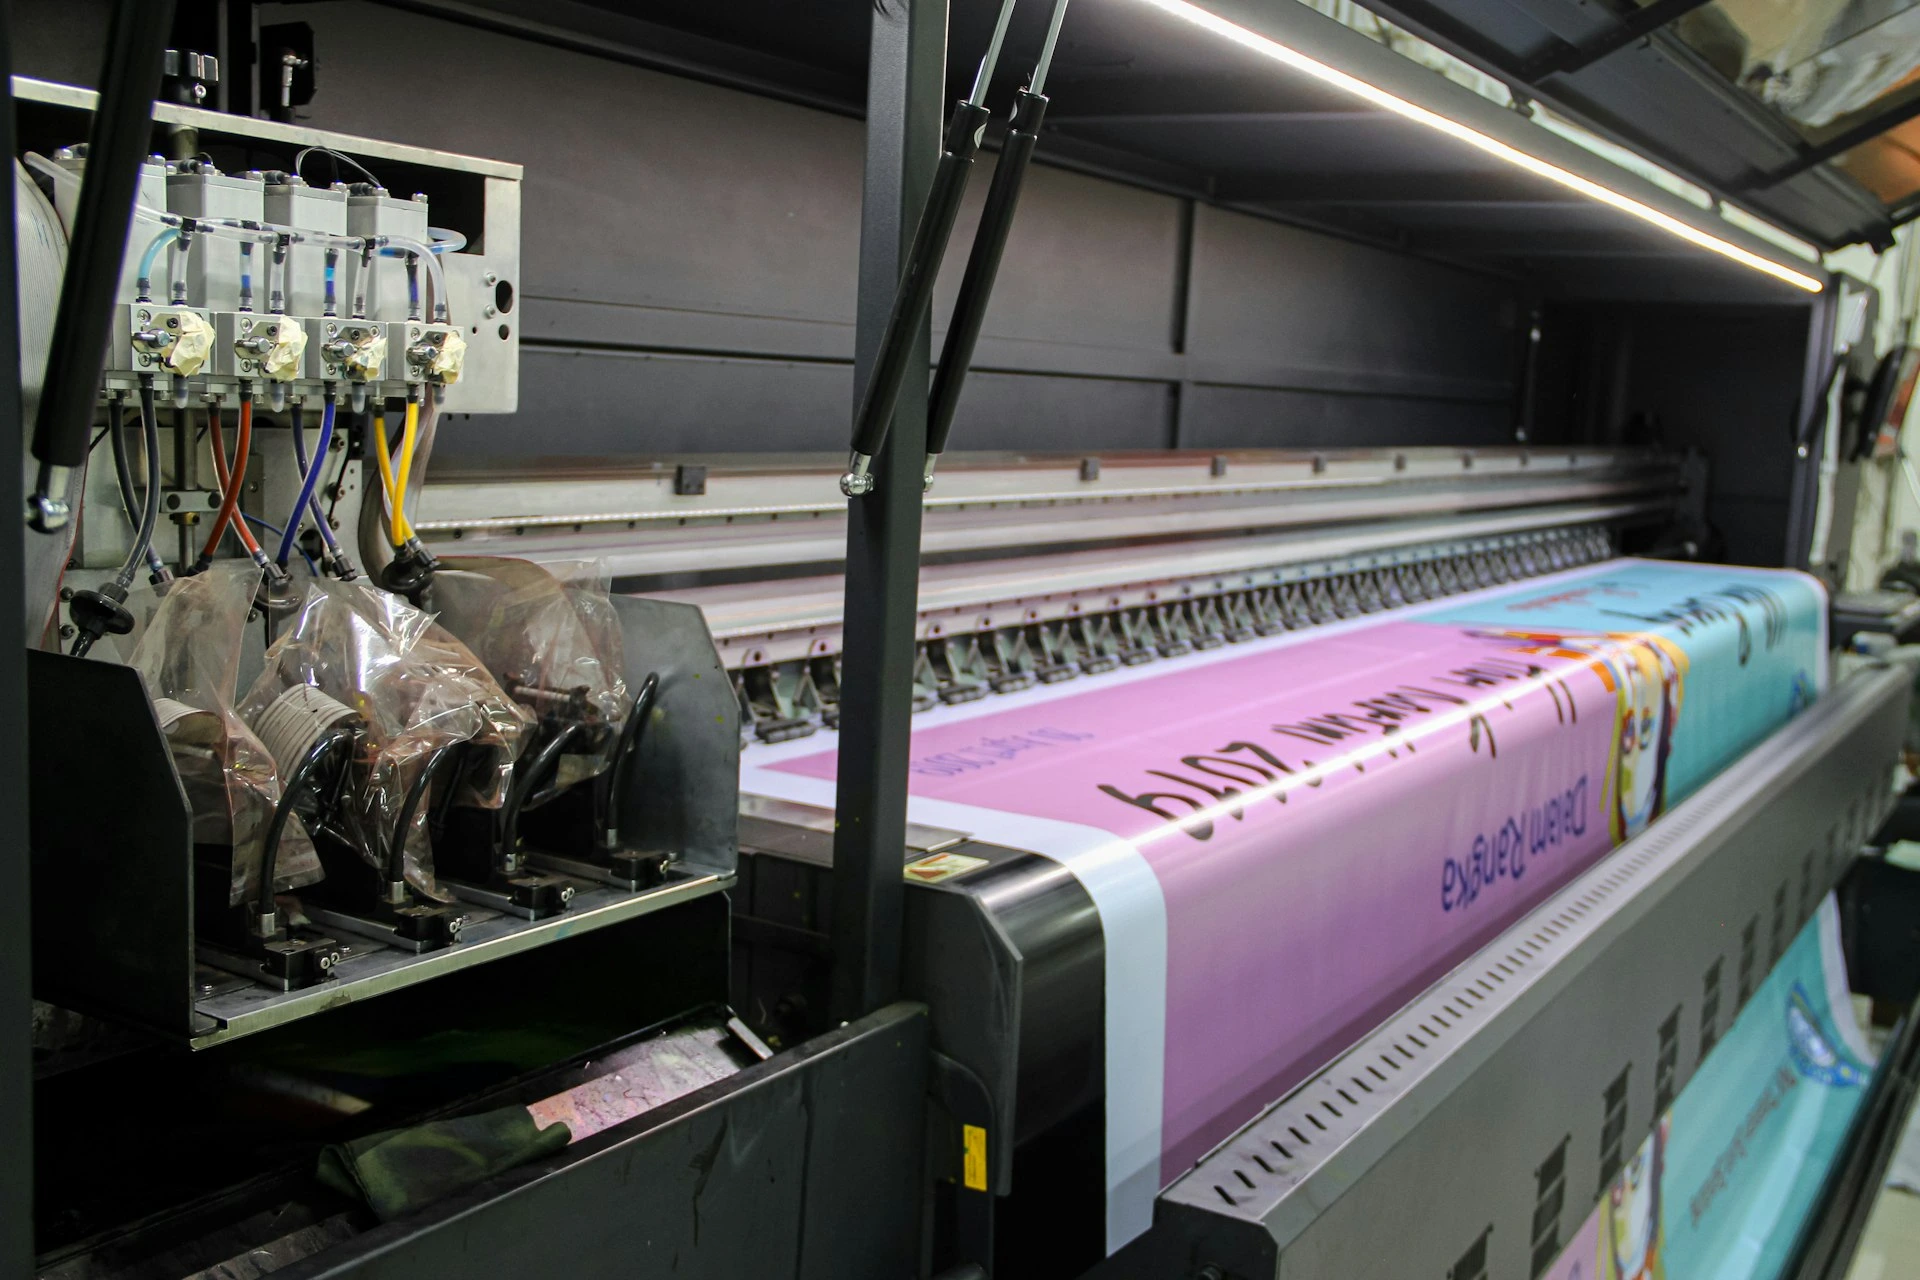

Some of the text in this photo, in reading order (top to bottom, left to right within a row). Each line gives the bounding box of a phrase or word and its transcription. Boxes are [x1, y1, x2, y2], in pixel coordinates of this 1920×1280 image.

[1096, 742, 1322, 841] 2019
[1442, 772, 1589, 913] Dalam Rangka
